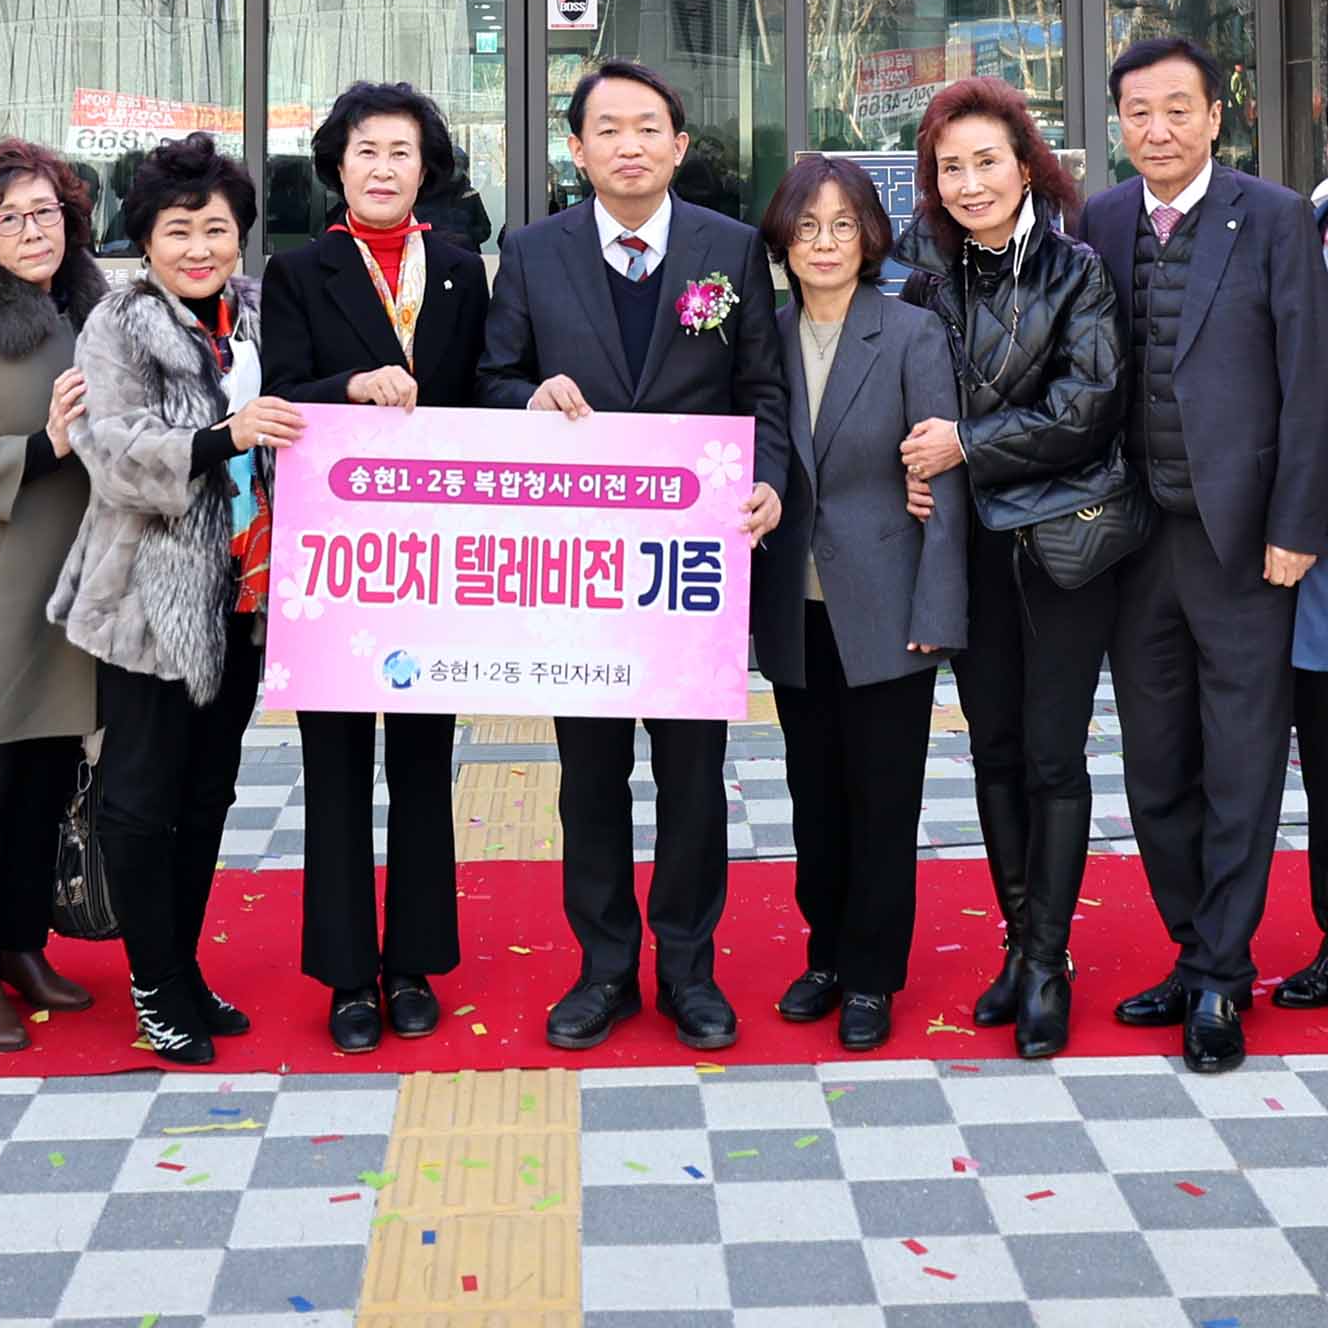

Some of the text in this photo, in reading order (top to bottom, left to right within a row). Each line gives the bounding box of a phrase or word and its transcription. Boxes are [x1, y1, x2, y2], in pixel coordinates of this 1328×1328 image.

[560, 1, 586, 12] BOSS
[348, 465, 683, 504] 송현1·2동 복합청사 이전 기념
[301, 532, 723, 612] 70인치 텔레비전 기증
[429, 660, 632, 686] 송현1·2동 주민자치회
